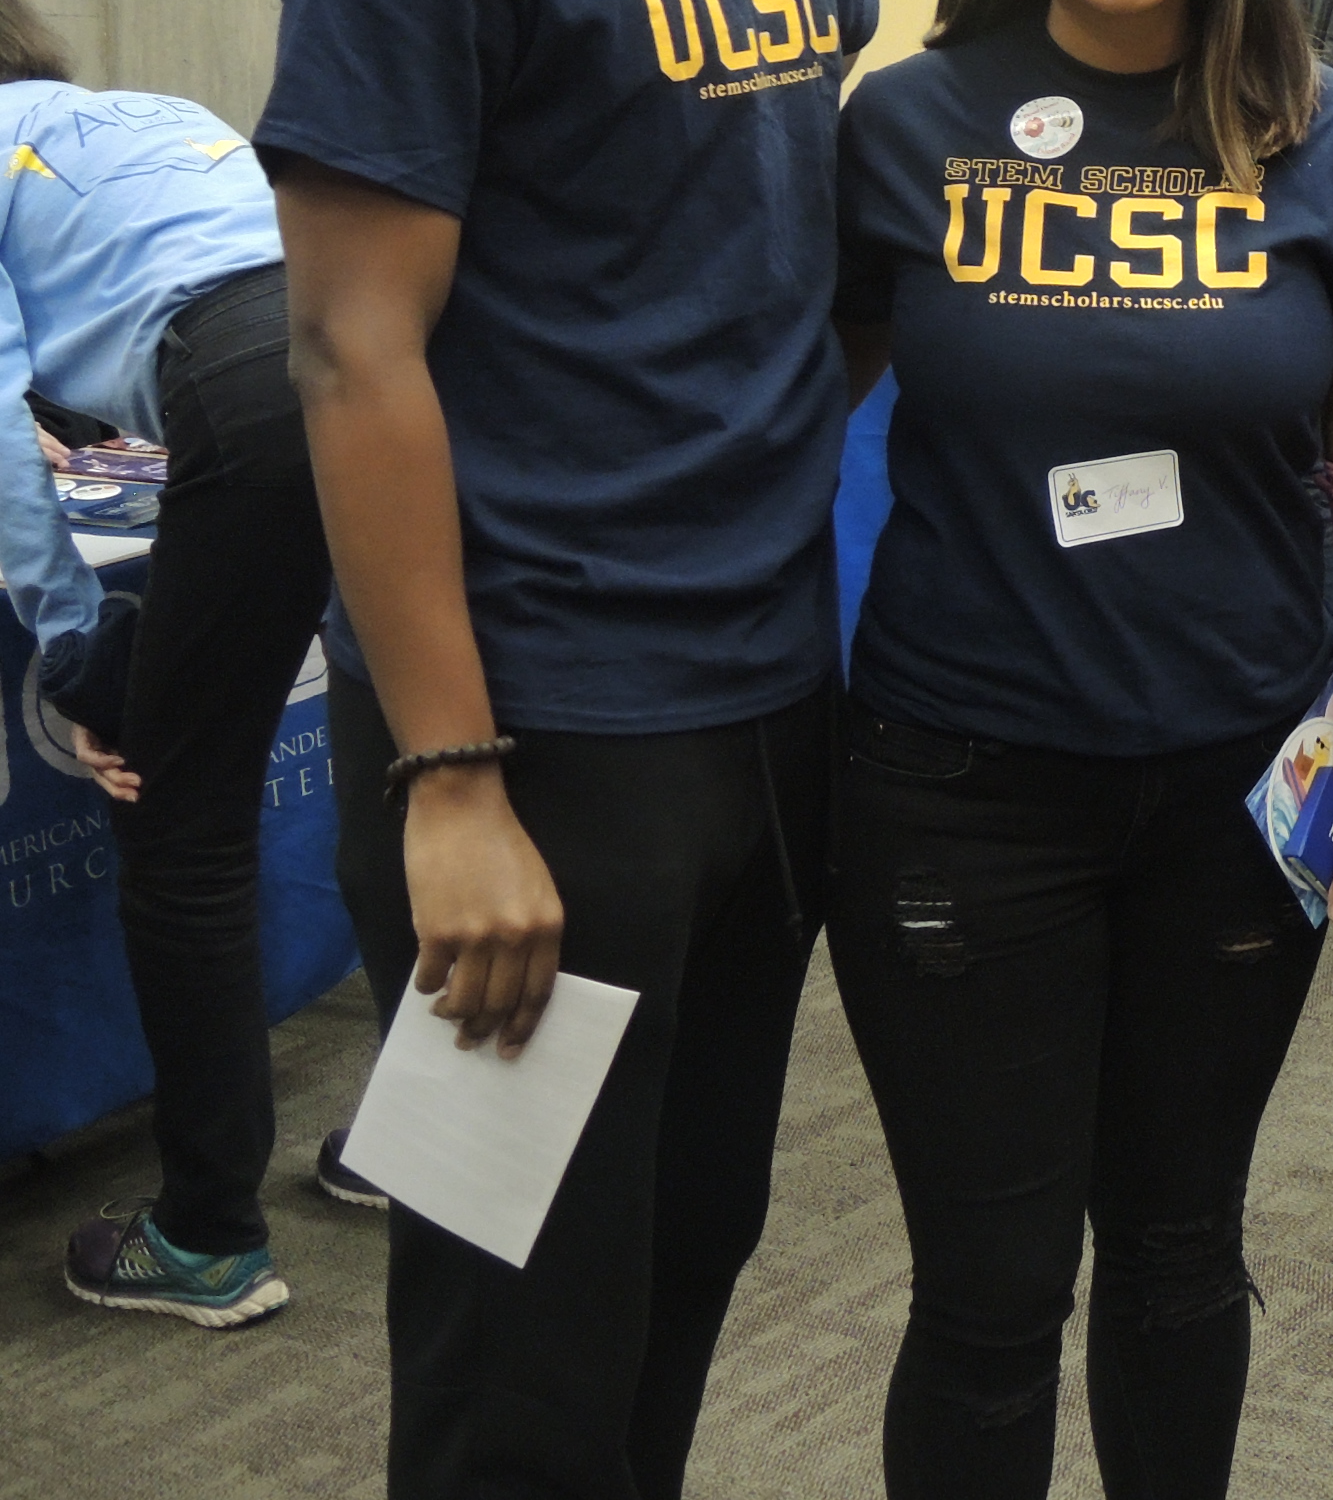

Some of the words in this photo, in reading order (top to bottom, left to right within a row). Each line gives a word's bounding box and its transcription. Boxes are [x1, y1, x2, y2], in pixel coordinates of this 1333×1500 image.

[65, 97, 199, 148] ACE
[944, 157, 1063, 189] STEM
[1080, 165, 1265, 197] SCHOLR
[943, 184, 1267, 288] UCSC
[988, 291, 1224, 310] stemscholars.ucsc.edu
